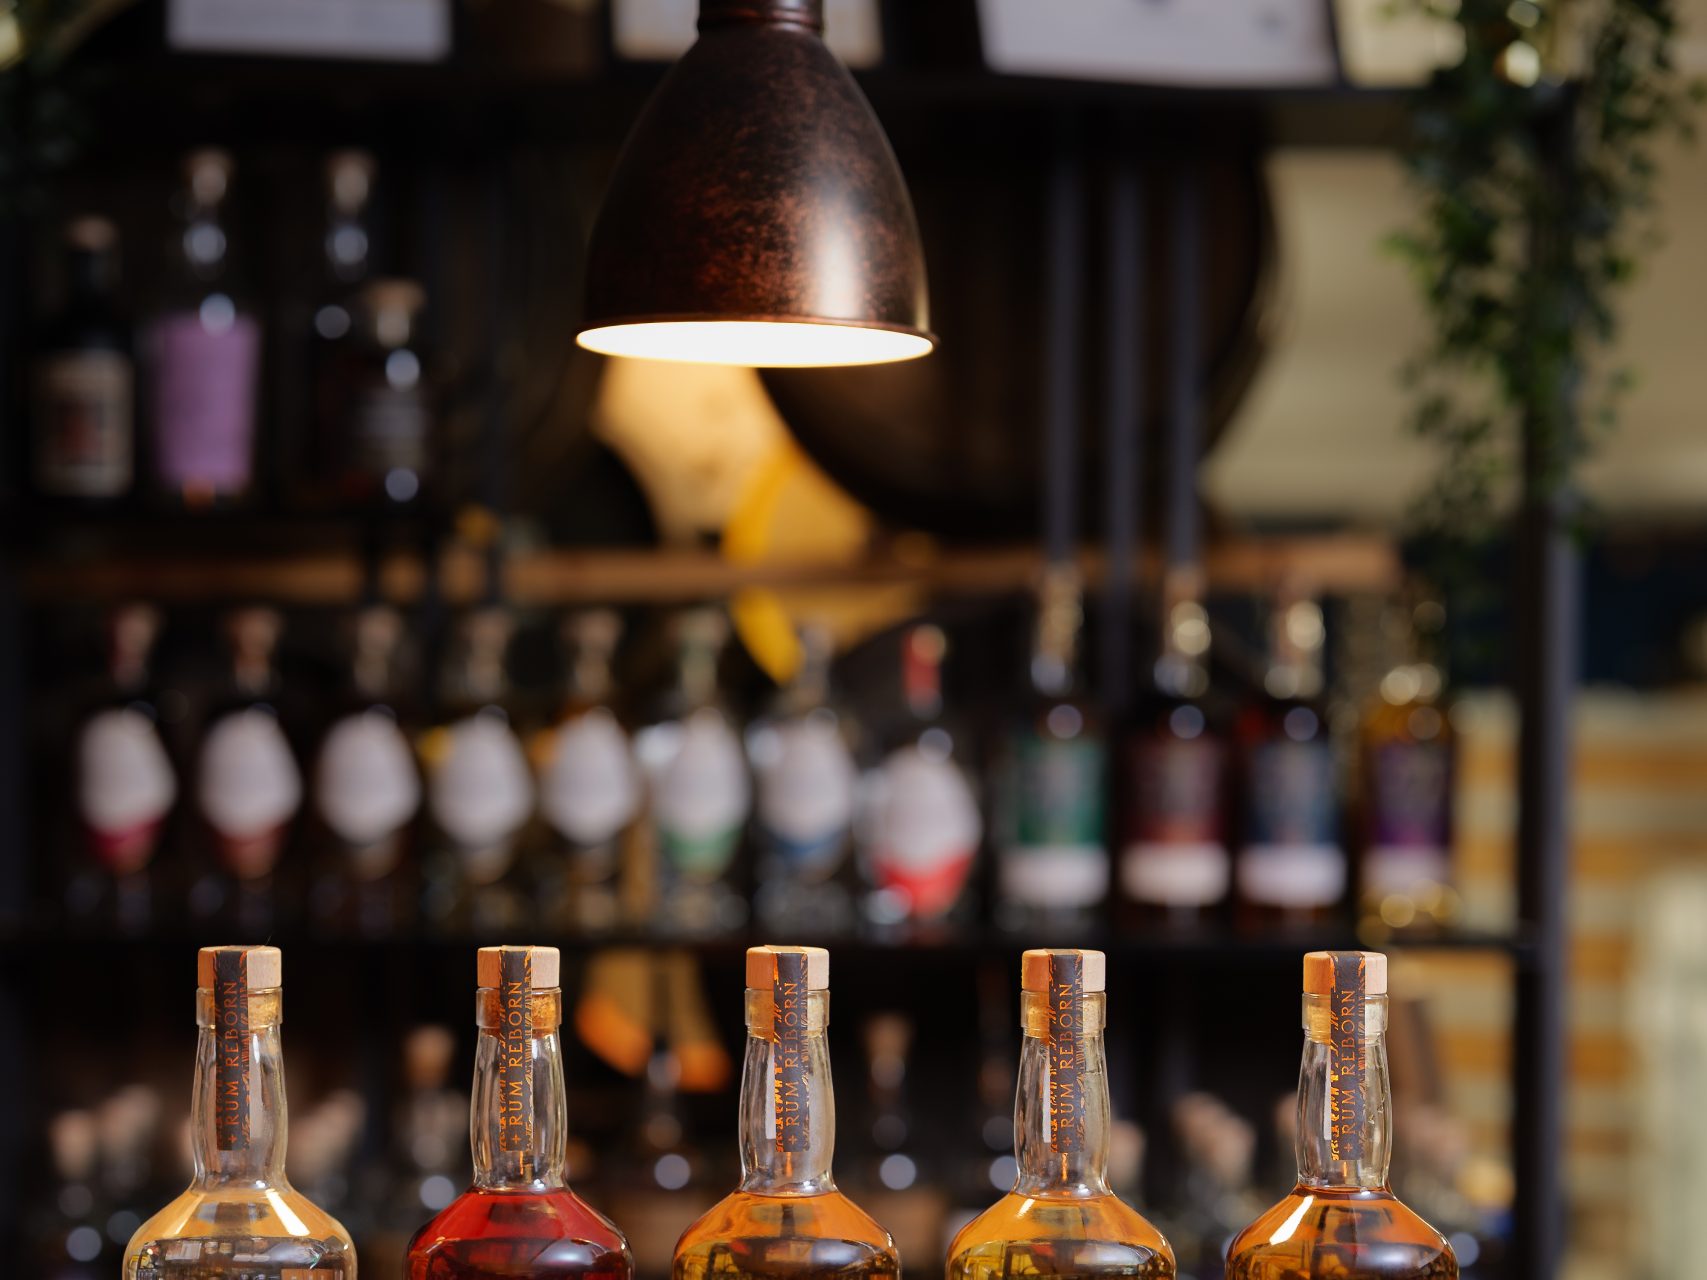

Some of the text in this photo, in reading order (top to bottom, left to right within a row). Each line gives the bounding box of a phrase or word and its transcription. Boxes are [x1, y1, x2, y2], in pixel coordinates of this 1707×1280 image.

[224, 981, 239, 1125] RUM REBORN
[508, 981, 523, 1126] RUM REBORN
[784, 983, 799, 1127] RUM REBORN
[1059, 984, 1074, 1130] RUM REBORN
[1341, 990, 1356, 1136] RUM REBORN
